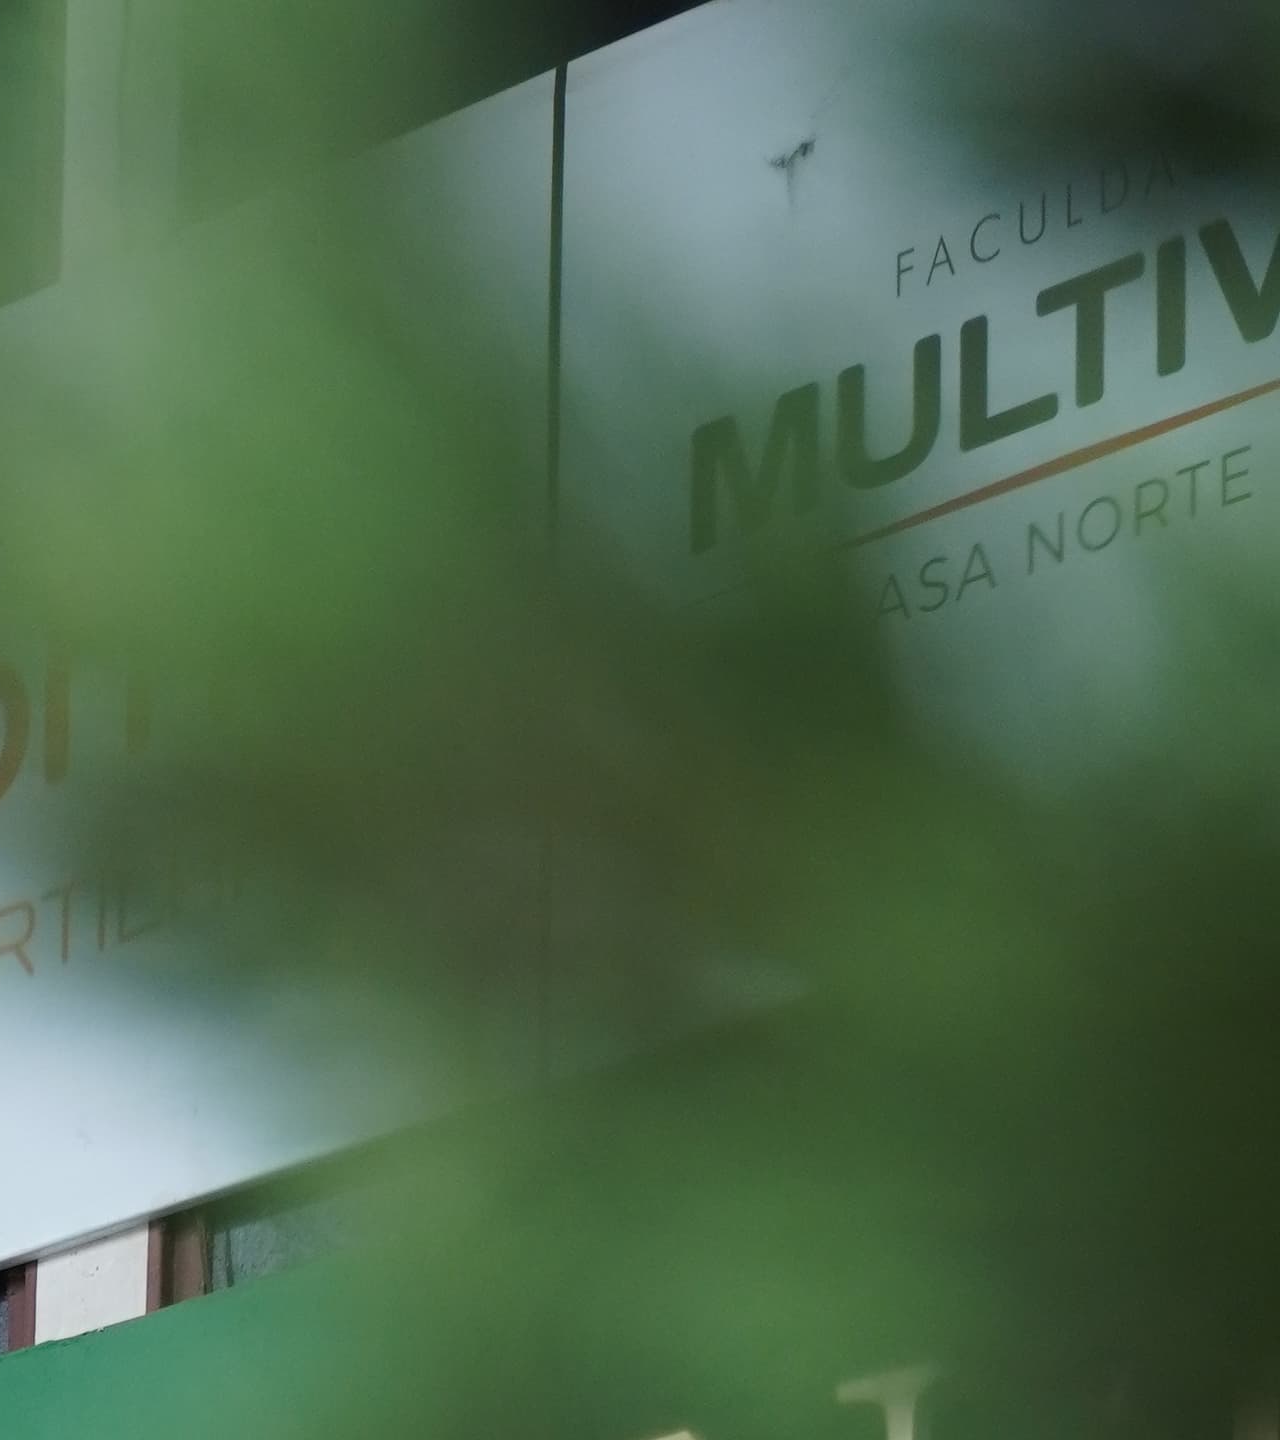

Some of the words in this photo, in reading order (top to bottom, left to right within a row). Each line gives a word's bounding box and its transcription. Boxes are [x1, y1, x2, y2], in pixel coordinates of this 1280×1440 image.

[893, 150, 1176, 299] FACULDA
[877, 541, 999, 622] ASA
[1025, 443, 1254, 577] NORTE
